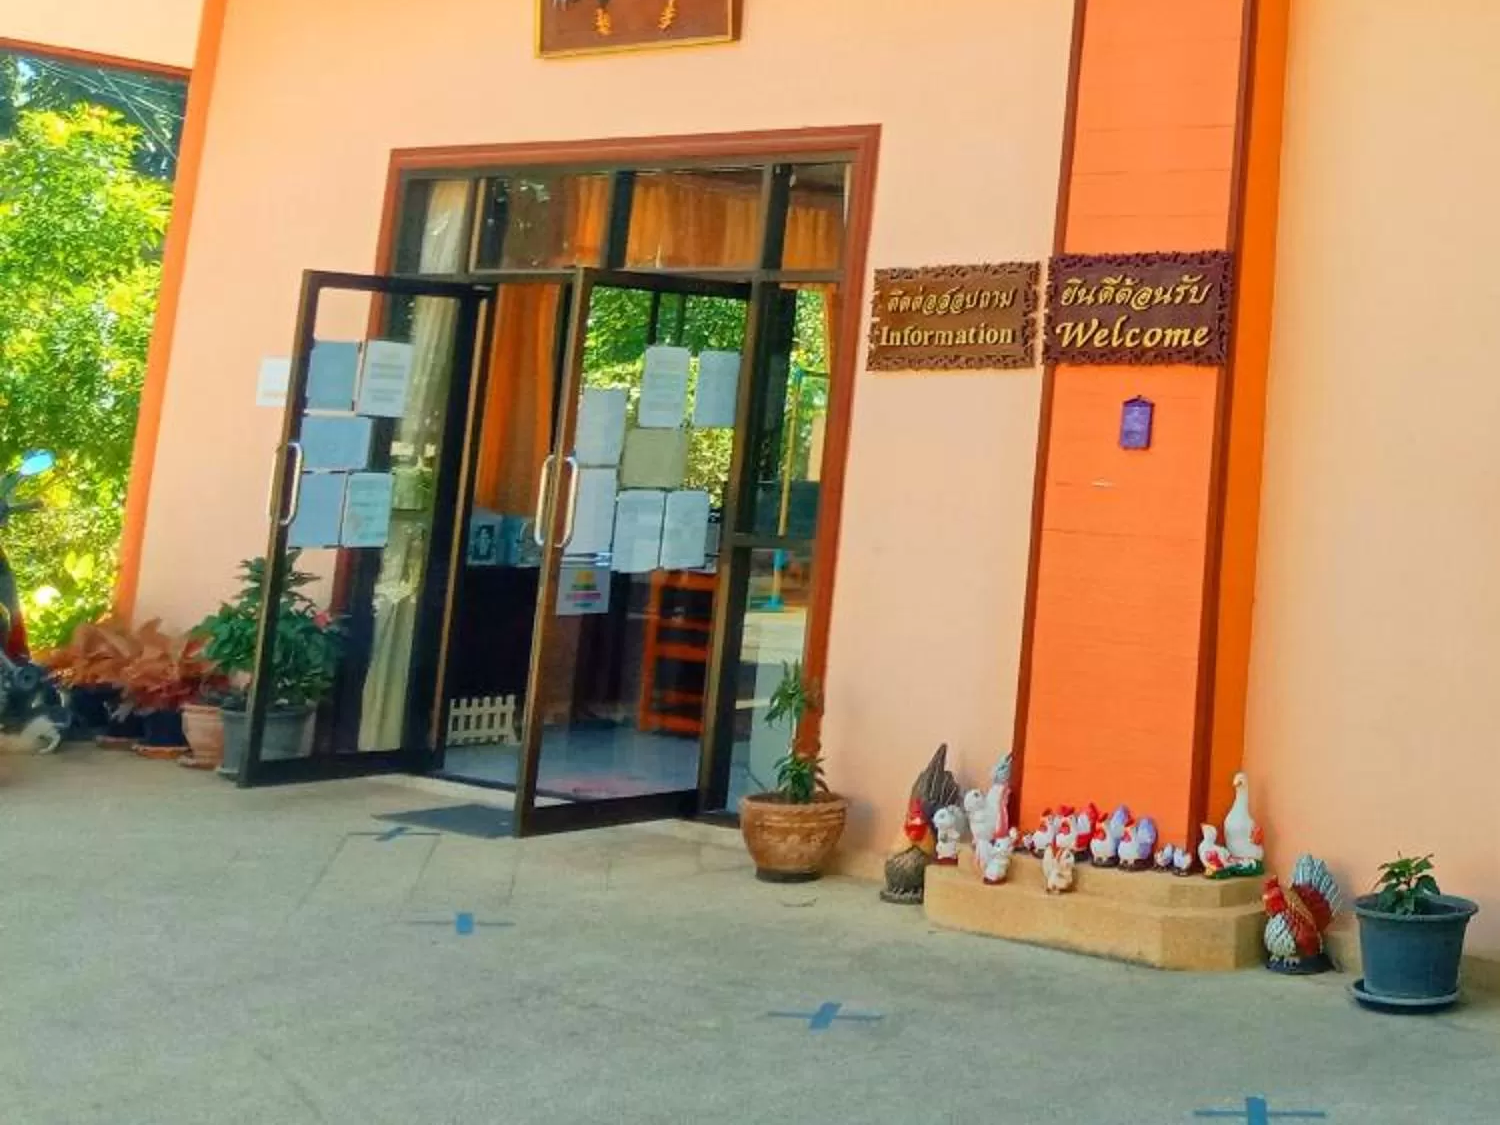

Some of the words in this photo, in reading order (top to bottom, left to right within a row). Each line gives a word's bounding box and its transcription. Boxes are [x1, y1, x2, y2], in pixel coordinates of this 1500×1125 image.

[887, 285, 1017, 316] ติดต่อสอบถาม
[1060, 275, 1212, 311] ยินดีต้อนรับ
[879, 322, 1014, 347] Information
[1055, 315, 1210, 348] Welcome
